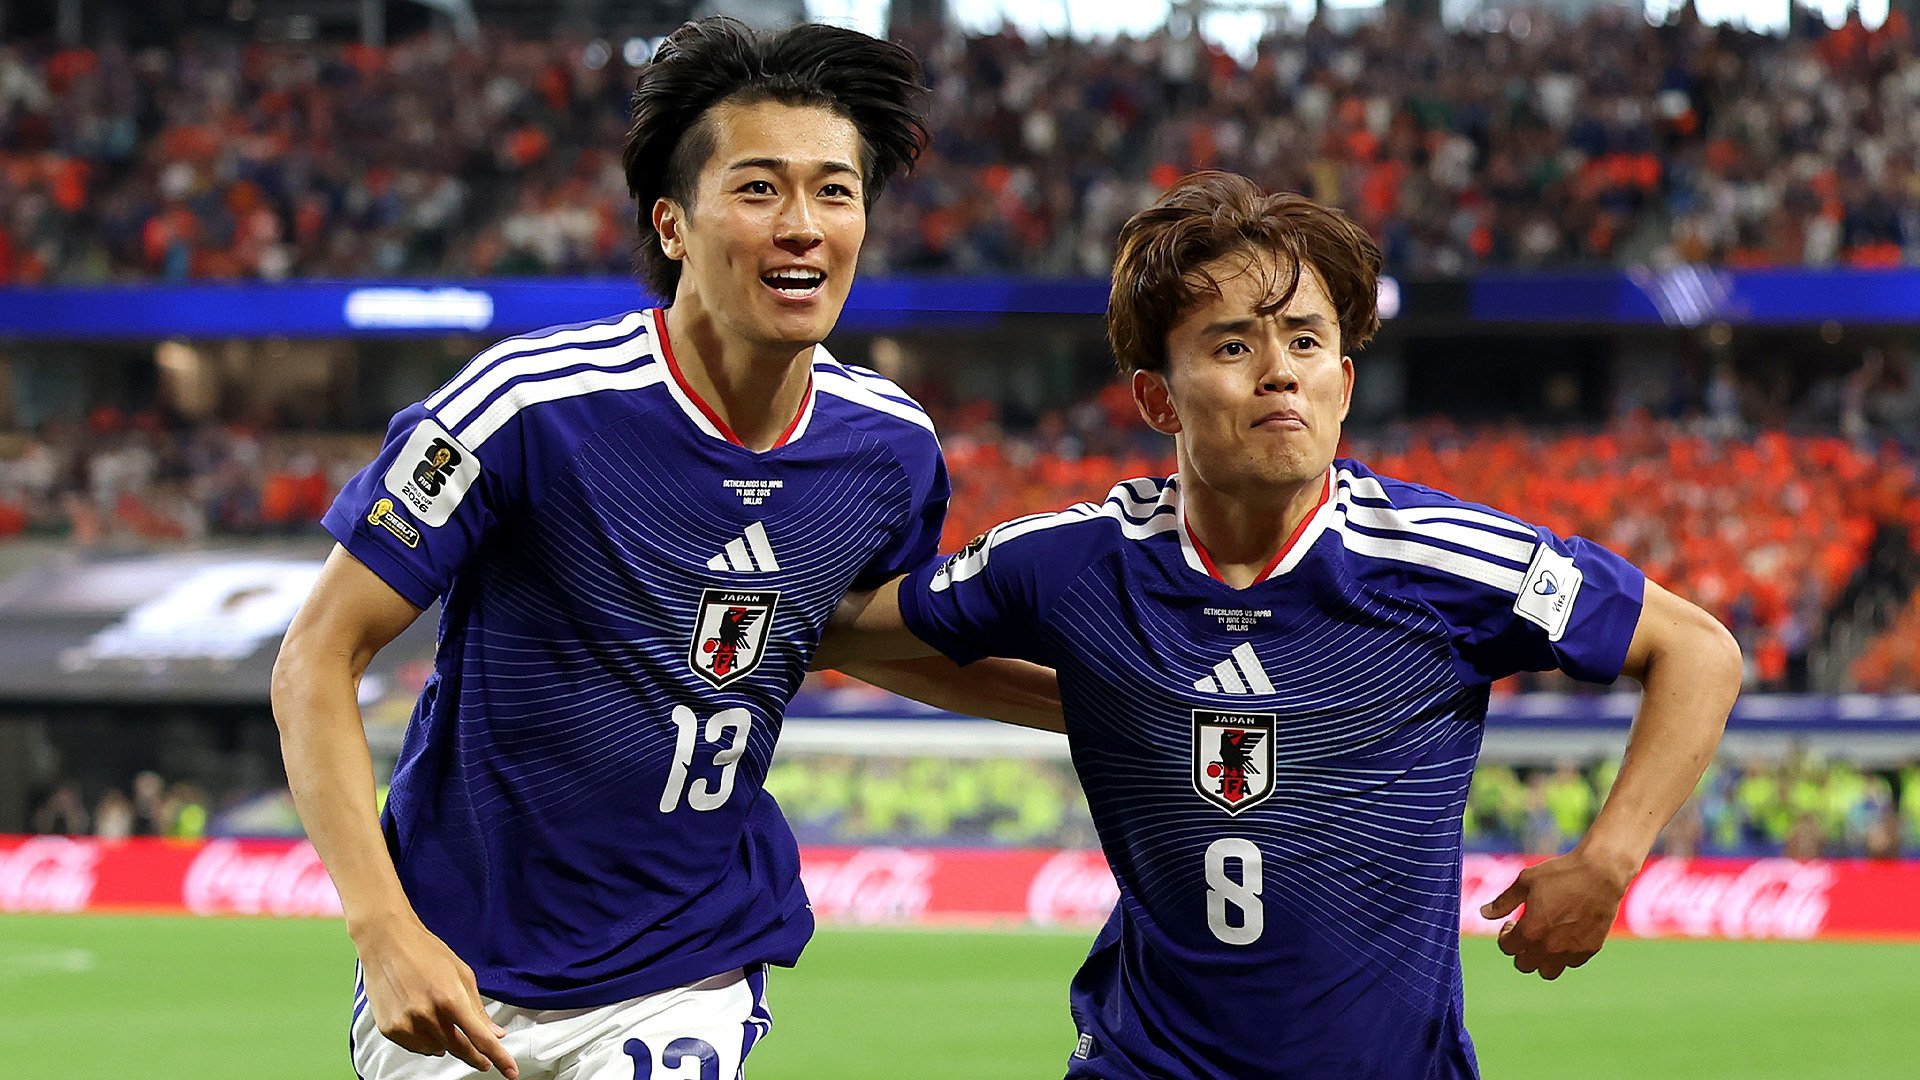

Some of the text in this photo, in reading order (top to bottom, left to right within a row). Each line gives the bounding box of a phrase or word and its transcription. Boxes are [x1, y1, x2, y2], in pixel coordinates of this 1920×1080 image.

[402, 485, 429, 513] 2026
[743, 497, 763, 505] DALLAS
[720, 593, 760, 602] JAPAN
[1555, 595, 1566, 612] FIFA
[1226, 624, 1249, 632] DALLAS
[1241, 617, 1257, 625] 2026
[705, 654, 739, 670] JFA
[1213, 715, 1255, 725] JAPAN
[659, 704, 752, 814] 13
[1214, 778, 1253, 796] JFA
[1204, 837, 1264, 946] 8
